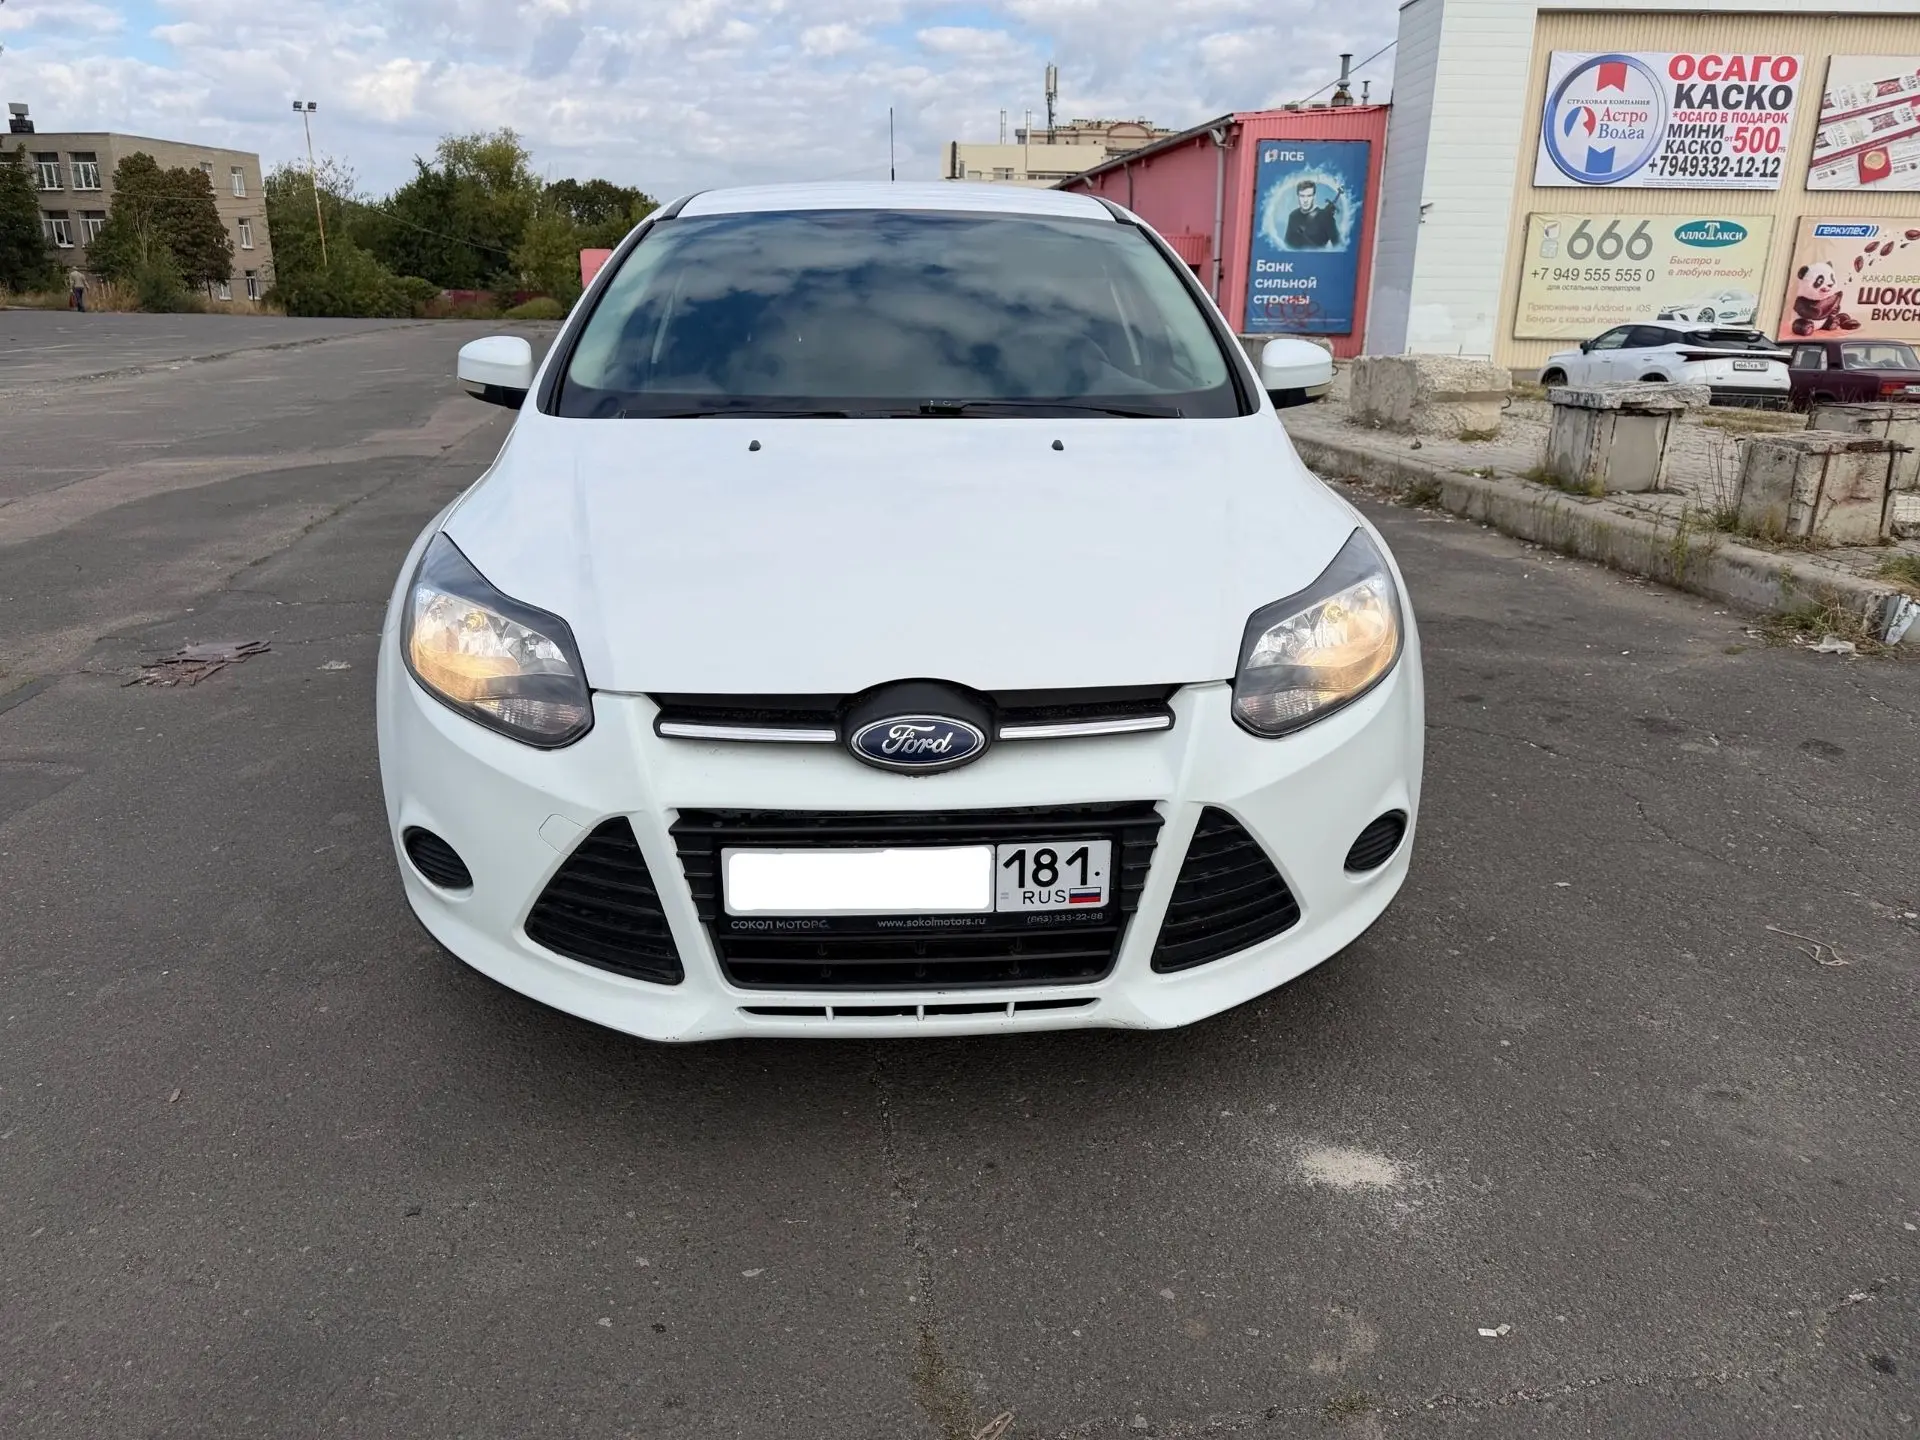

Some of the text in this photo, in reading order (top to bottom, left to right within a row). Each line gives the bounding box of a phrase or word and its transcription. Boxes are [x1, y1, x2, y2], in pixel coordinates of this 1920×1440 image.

[1668, 54, 1798, 82] ОСАГО
[1673, 83, 1793, 110] КАСКО
[1600, 106, 1648, 127] Астро
[1720, 112, 1728, 123] В
[1731, 112, 1789, 125] ПОДАРОК
[1597, 123, 1644, 139] Волга
[1667, 123, 1725, 139] МИНИ
[1664, 139, 1723, 155] КАСКО
[1732, 126, 1781, 154] 500
[1280, 151, 1304, 161] ПСБ
[1649, 155, 1781, 178] +7949332-12-12
[1567, 219, 1653, 260] 666
[1256, 259, 1294, 272] Банк
[1669, 256, 1712, 266] Быстро
[1531, 267, 1655, 282] +7 949 555 555 0
[1675, 268, 1711, 278] любую
[1713, 268, 1753, 279] погоду!
[1862, 275, 1893, 283] КАКАО
[1254, 277, 1317, 288] сильной
[1253, 294, 1310, 307] страны
[882, 724, 952, 755] Ford
[1003, 846, 1089, 889] 181
[1023, 890, 1067, 904] RUS
[731, 920, 773, 929] СОКОЛ
[877, 916, 987, 928] www.sokolmotors.ru
